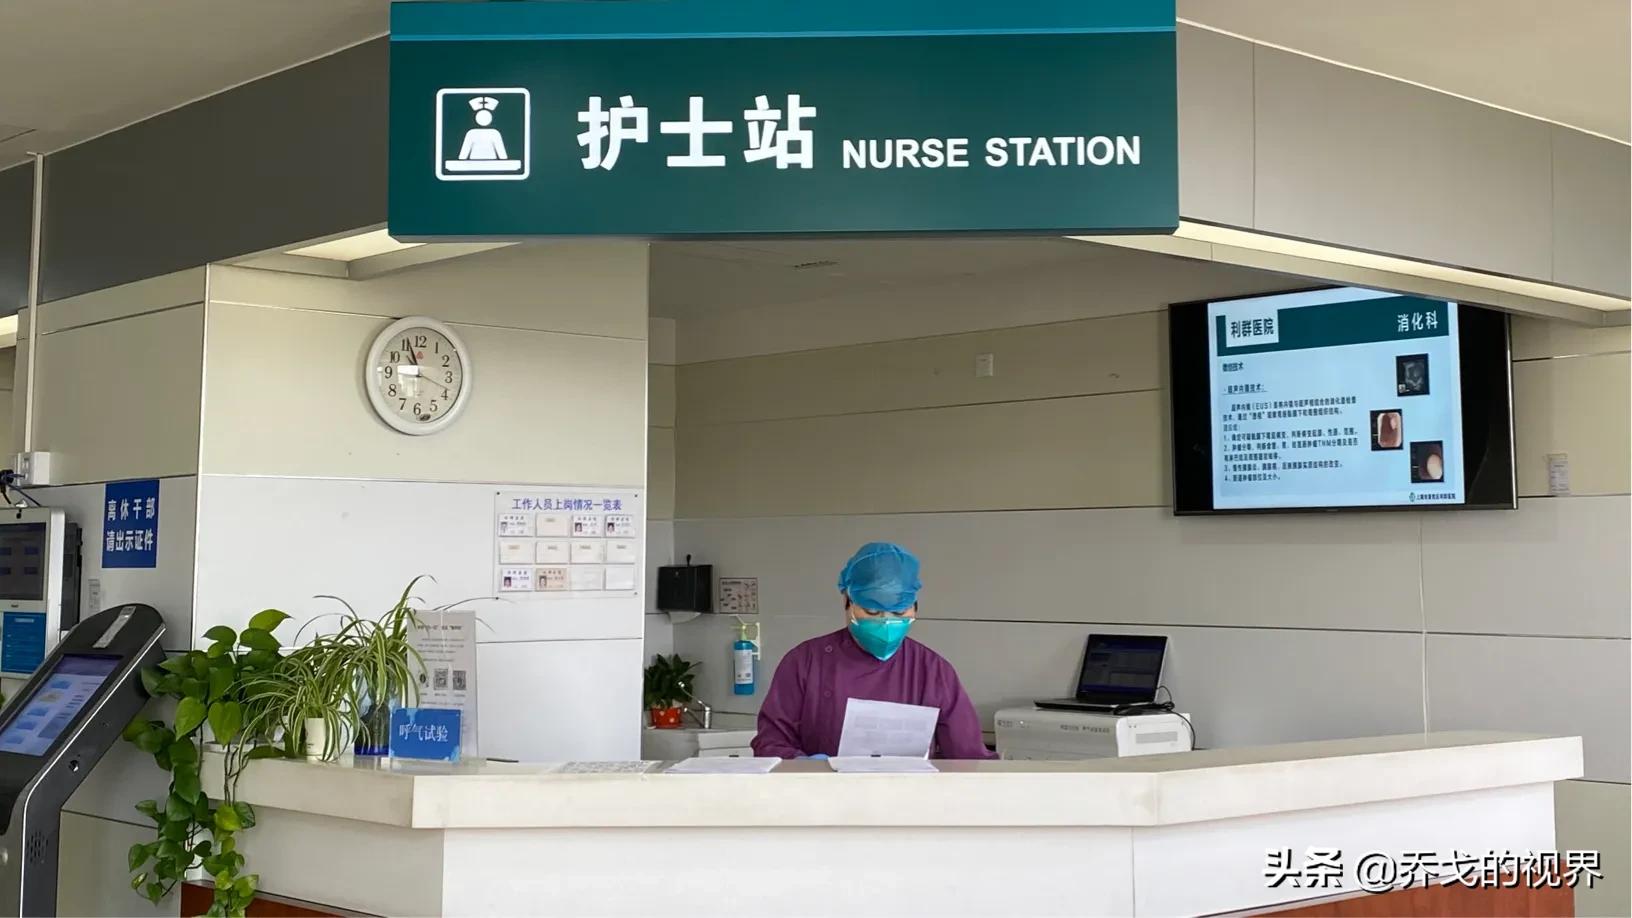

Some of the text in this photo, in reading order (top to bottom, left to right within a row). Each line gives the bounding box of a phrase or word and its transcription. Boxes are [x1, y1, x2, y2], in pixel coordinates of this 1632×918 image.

[576, 94, 817, 171] 护士站
[842, 135, 1141, 169] NURSE STATION
[1230, 317, 1275, 339] 利群医院
[1397, 310, 1439, 333] 消化科
[414, 335, 427, 348] 12
[390, 351, 400, 363] 10
[442, 355, 450, 368] 2
[384, 366, 393, 379] 9
[444, 371, 453, 384] 3
[388, 384, 397, 397] 8
[440, 388, 449, 400] 4
[398, 398, 407, 410] 7
[413, 402, 421, 416] 6
[429, 400, 438, 412] 5
[107, 497, 156, 520] 离休干部
[511, 498, 623, 511] 工作人员上岗情况一览表
[106, 529, 154, 552] 请出示证件
[398, 722, 449, 742] 呼气试验
